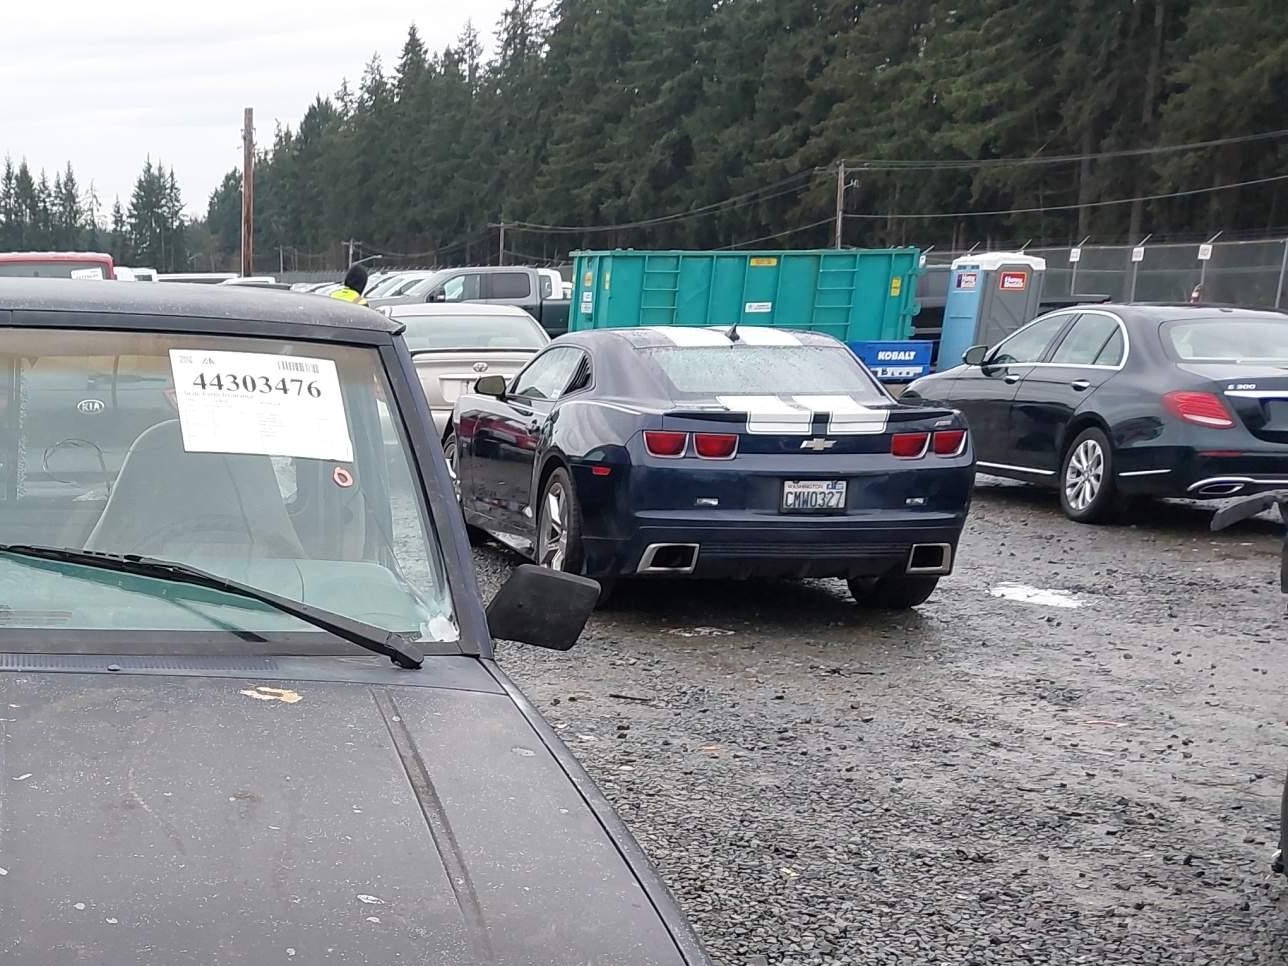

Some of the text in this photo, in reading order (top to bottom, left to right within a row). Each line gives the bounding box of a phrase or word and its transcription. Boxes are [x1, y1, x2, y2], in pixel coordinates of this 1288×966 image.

[877, 351, 917, 361] KOBALT
[192, 371, 323, 399] 44303476
[81, 400, 101, 413] KIA
[785, 491, 844, 508] CMW0327
